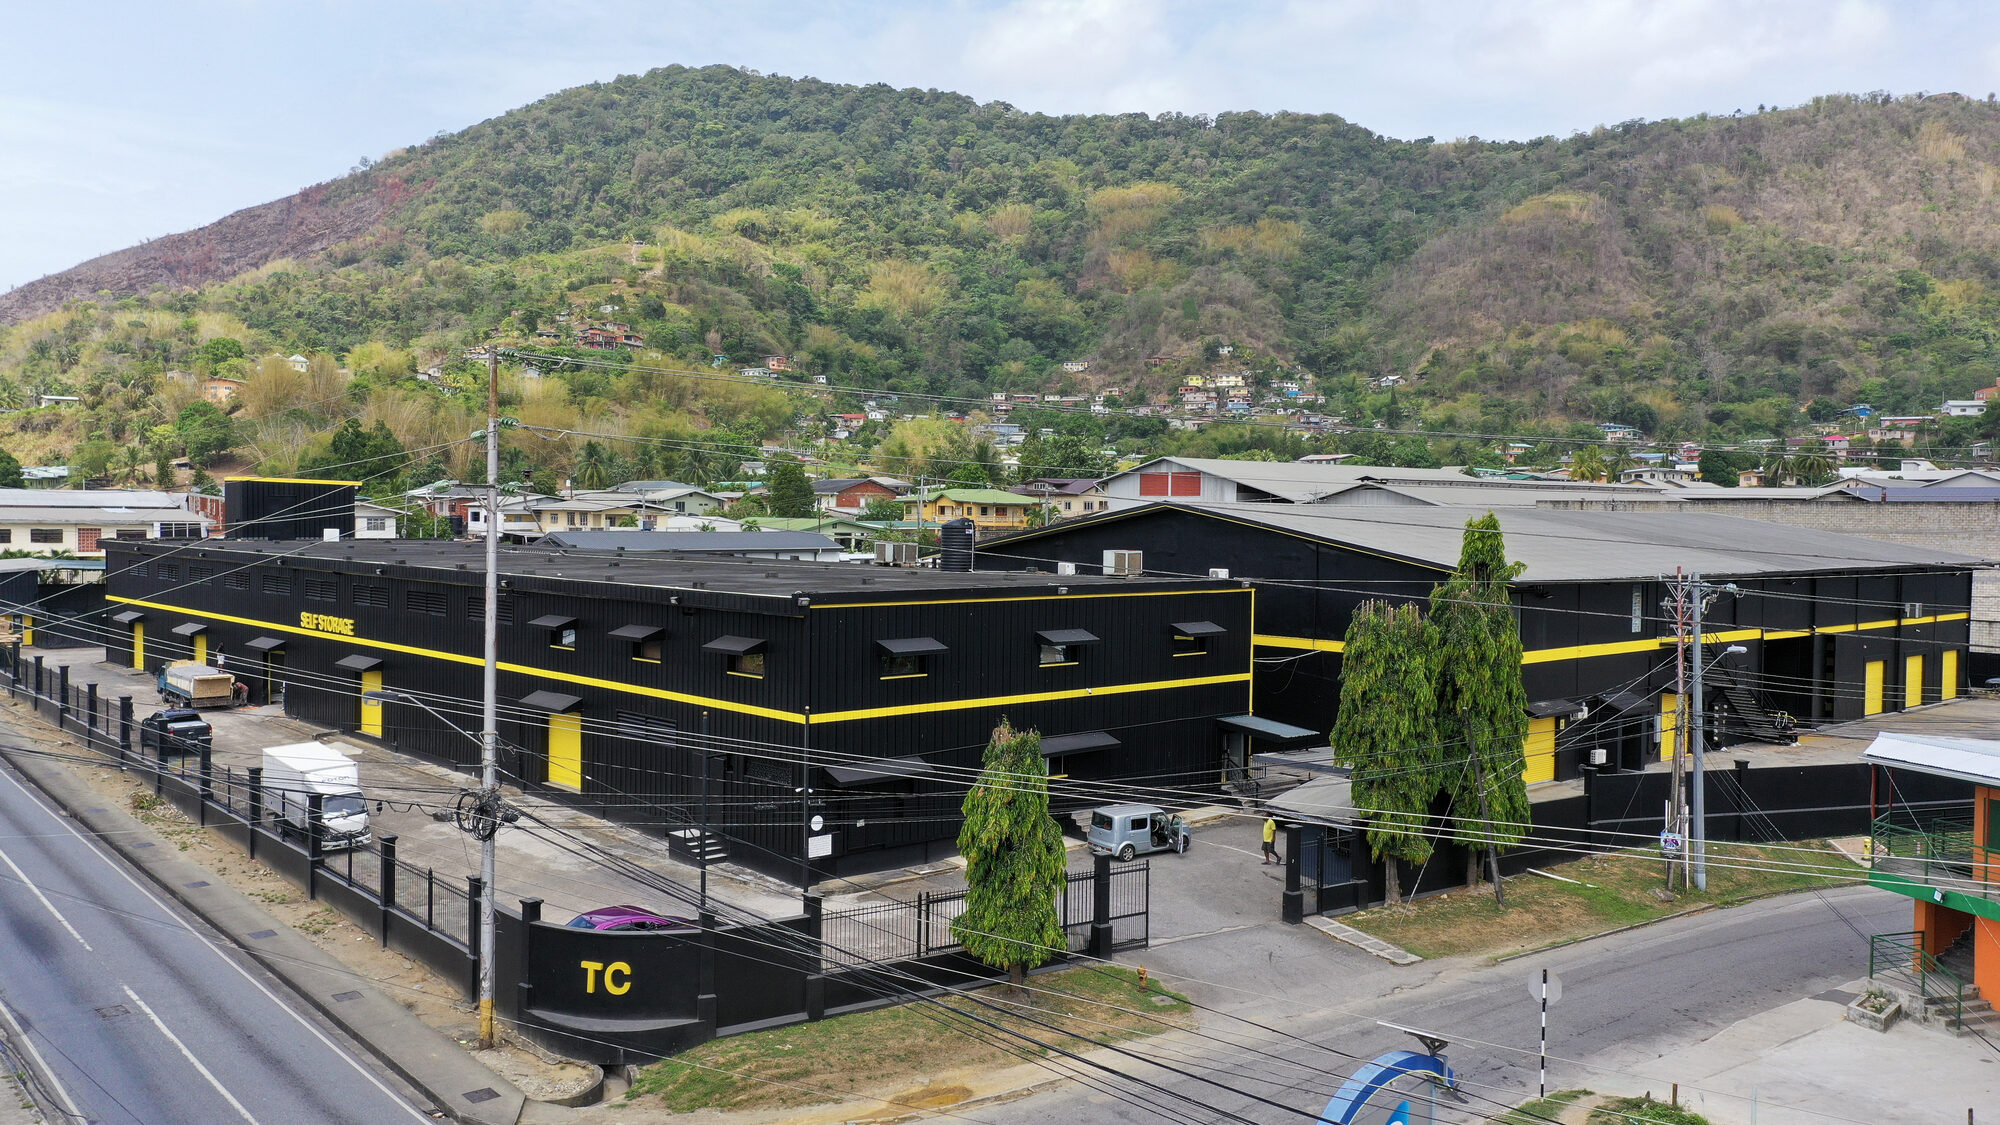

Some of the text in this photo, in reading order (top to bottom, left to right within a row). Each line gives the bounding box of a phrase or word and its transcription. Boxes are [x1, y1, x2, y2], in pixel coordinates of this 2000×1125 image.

[300, 611, 355, 635] SELF STORAGE
[580, 960, 632, 996] TC
